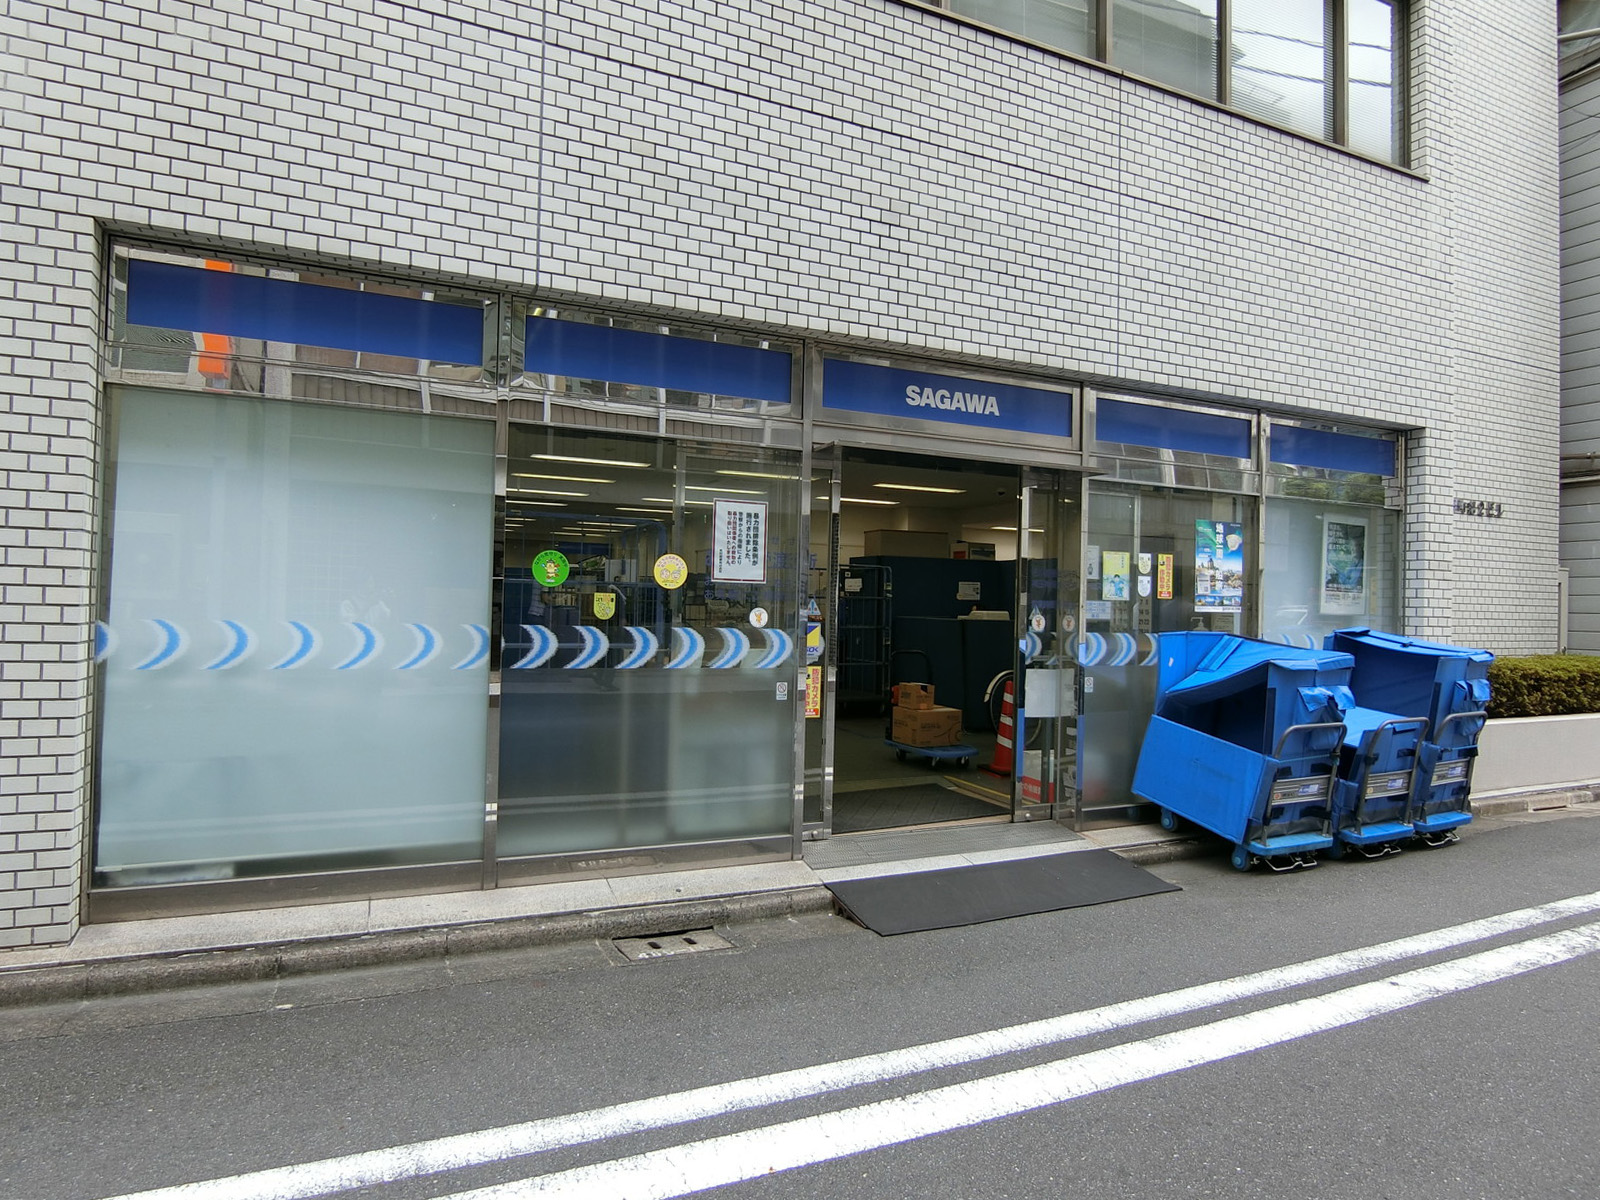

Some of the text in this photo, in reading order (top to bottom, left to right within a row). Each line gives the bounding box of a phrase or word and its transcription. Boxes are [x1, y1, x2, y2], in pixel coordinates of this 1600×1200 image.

[905, 385, 1000, 416] SAGAWA
[811, 667, 820, 707] 防犯カメラ
